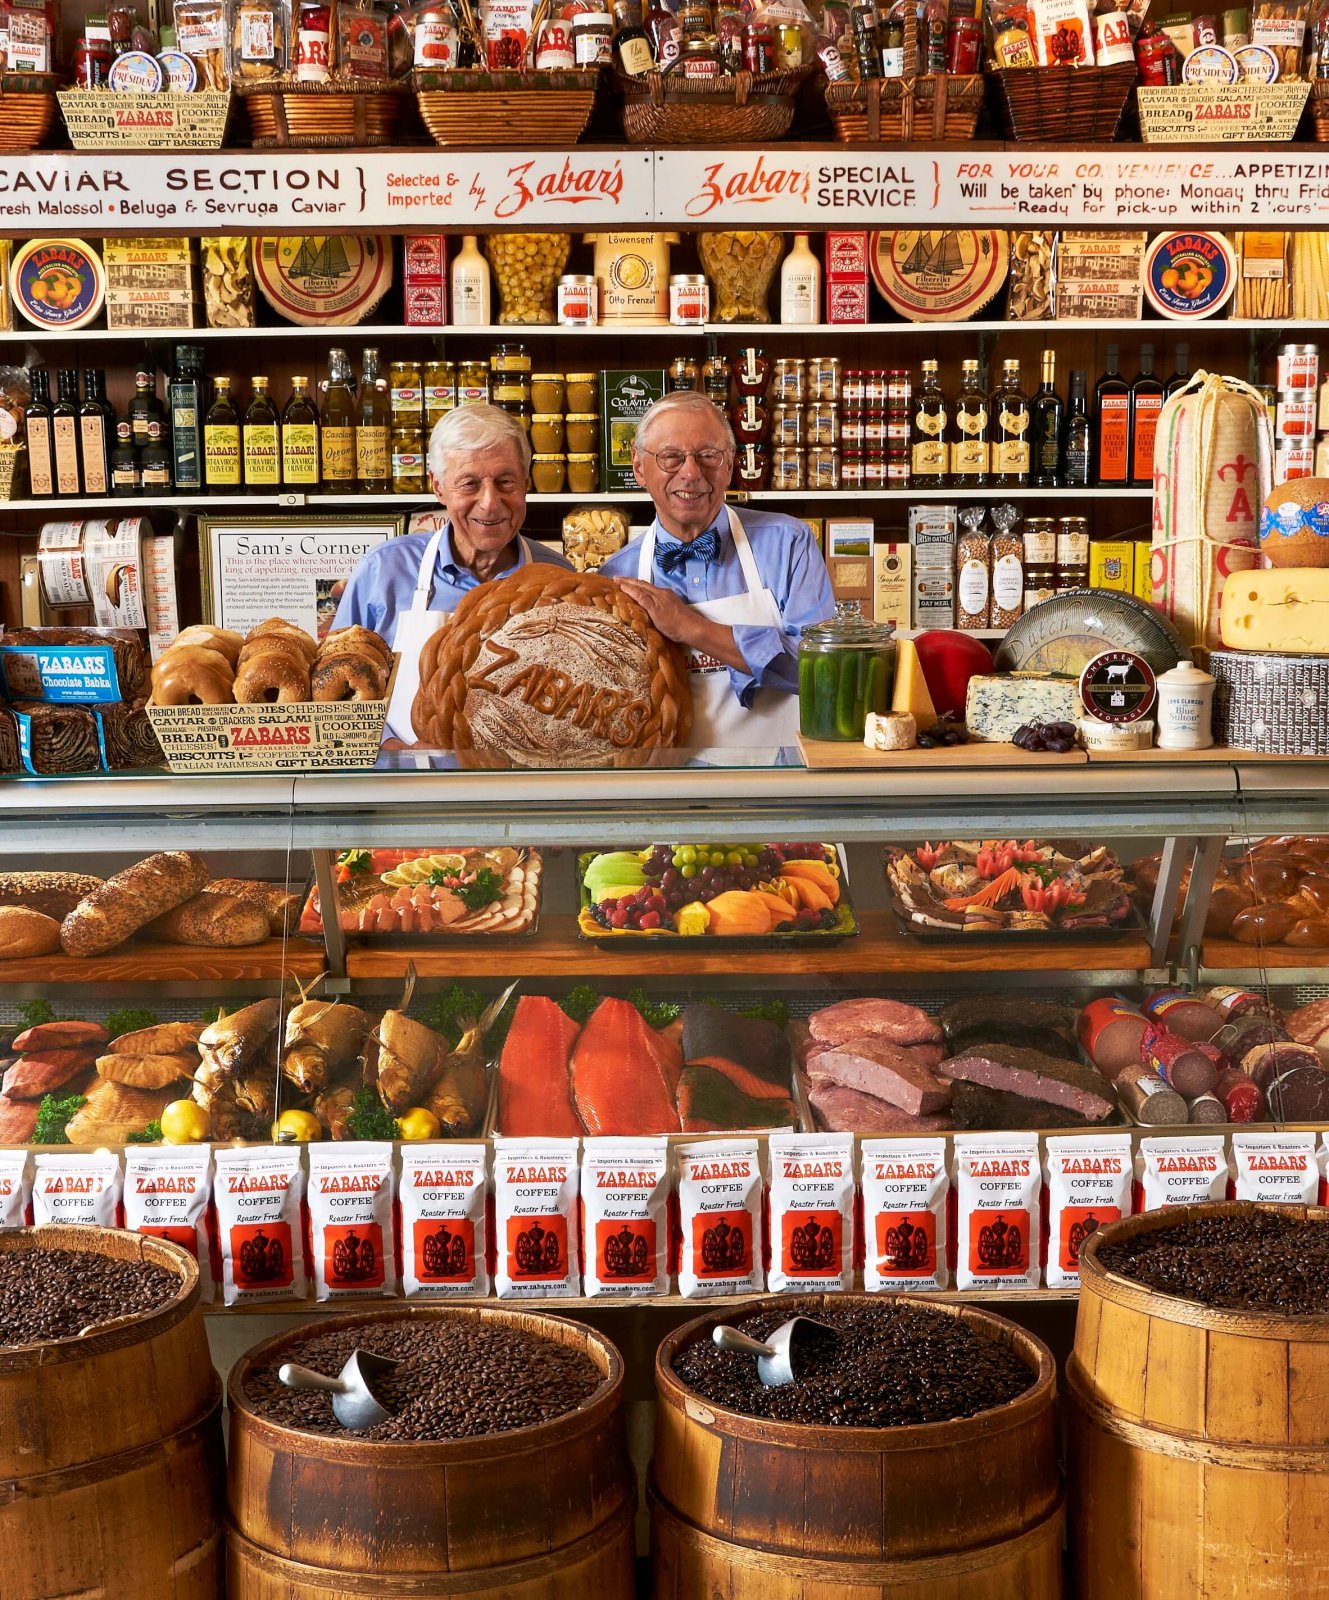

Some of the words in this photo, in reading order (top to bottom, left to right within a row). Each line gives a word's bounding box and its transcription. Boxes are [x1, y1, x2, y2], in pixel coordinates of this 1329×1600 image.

[817, 166, 915, 184] SPECIAL
[956, 164, 993, 178] FOR
[1008, 164, 1060, 178] YOUR
[166, 168, 339, 191] SECTION
[386, 173, 440, 187] Selected
[446, 173, 459, 186] &
[468, 172, 487, 211] by
[960, 183, 987, 198] Will
[1000, 183, 1019, 198] be
[1029, 183, 1073, 198] taken
[1083, 183, 1102, 201] by
[1115, 184, 1170, 200] phone:
[1255, 184, 1289, 198] thru
[387, 191, 453, 208] Imported
[817, 188, 916, 207] SERVICE
[38, 200, 103, 215] Malossol
[120, 200, 177, 218] Beluga
[185, 200, 198, 213] &
[205, 199, 278, 216] Sevruga
[291, 198, 346, 213] Caviar
[1018, 201, 1068, 216] Ready
[1083, 201, 1105, 213] for
[1117, 202, 1178, 216] pick-up
[1191, 201, 1241, 213] within
[1250, 202, 1260, 212] 2
[608, 234, 654, 244] Löwensenf
[611, 397, 654, 407] COLAVITA
[236, 536, 292, 556] Sam's
[300, 536, 370, 555] Corner
[227, 557, 244, 565] This
[256, 557, 267, 565] the
[270, 557, 292, 567] place
[294, 557, 317, 565] where
[225, 566, 242, 574] king
[244, 566, 253, 574] of
[302, 566, 332, 576] reigned
[334, 566, 346, 574] for
[42, 676, 82, 687] Chocolate
[150, 708, 176, 716] FRENCH
[178, 708, 200, 716] BREAD
[286, 704, 350, 714] CHEESES
[153, 718, 205, 726] CAVIAR
[218, 716, 256, 725] CRACKERS
[258, 715, 311, 724] SALAMI
[322, 721, 383, 731] COOKIES
[161, 733, 217, 743] BREAD
[230, 726, 311, 746] ZABAR'S
[168, 752, 235, 760] BISCUITS
[257, 751, 299, 759] COFFEE
[216, 760, 272, 768] PARMESAN
[276, 759, 308, 767] GIFT
[310, 758, 376, 766] BASKETS
[1061, 1158, 1122, 1174] ZABAR'S
[1157, 1156, 1218, 1172] ZABAR'S
[1248, 1155, 1307, 1171] ZABAR'S
[690, 1162, 750, 1180] ZABAR'S
[783, 1162, 843, 1178] ZABAR'S
[875, 1163, 936, 1180] ZABAR'S
[970, 1160, 1030, 1177] ZABAR'S
[414, 1170, 474, 1187] ZABAR'S
[506, 1167, 567, 1183] ZABAR'S
[596, 1171, 657, 1188] ZABAR'S
[1258, 1176, 1300, 1184] COFFEE
[136, 1176, 196, 1194] ZABAR'S
[228, 1174, 289, 1194] ZABAR'S
[320, 1174, 381, 1193] ZABAR'S
[980, 1182, 1022, 1190] COFFEE
[1167, 1177, 1210, 1186] COFFEE
[516, 1189, 558, 1197] COFFEE
[701, 1184, 743, 1194] COFFEE
[792, 1184, 834, 1192] COFFEE
[885, 1184, 927, 1192] COFFEE
[238, 1196, 281, 1206] COFFEE
[422, 1192, 465, 1200] COFFEE
[1257, 1192, 1282, 1200] Roaster
[1284, 1192, 1302, 1200] Fresh
[54, 1198, 94, 1207] COFFEE
[145, 1198, 186, 1207] COFFEE
[330, 1197, 372, 1206] COFFEE
[883, 1200, 908, 1209] Roaster
[909, 1200, 929, 1208] Fresh
[514, 1205, 540, 1213] Roaster
[540, 1204, 560, 1212] Fresh
[236, 1214, 262, 1222] Roaster
[511, 1283, 567, 1291] www.zabars.com
[697, 1279, 752, 1288] www.zabars.com
